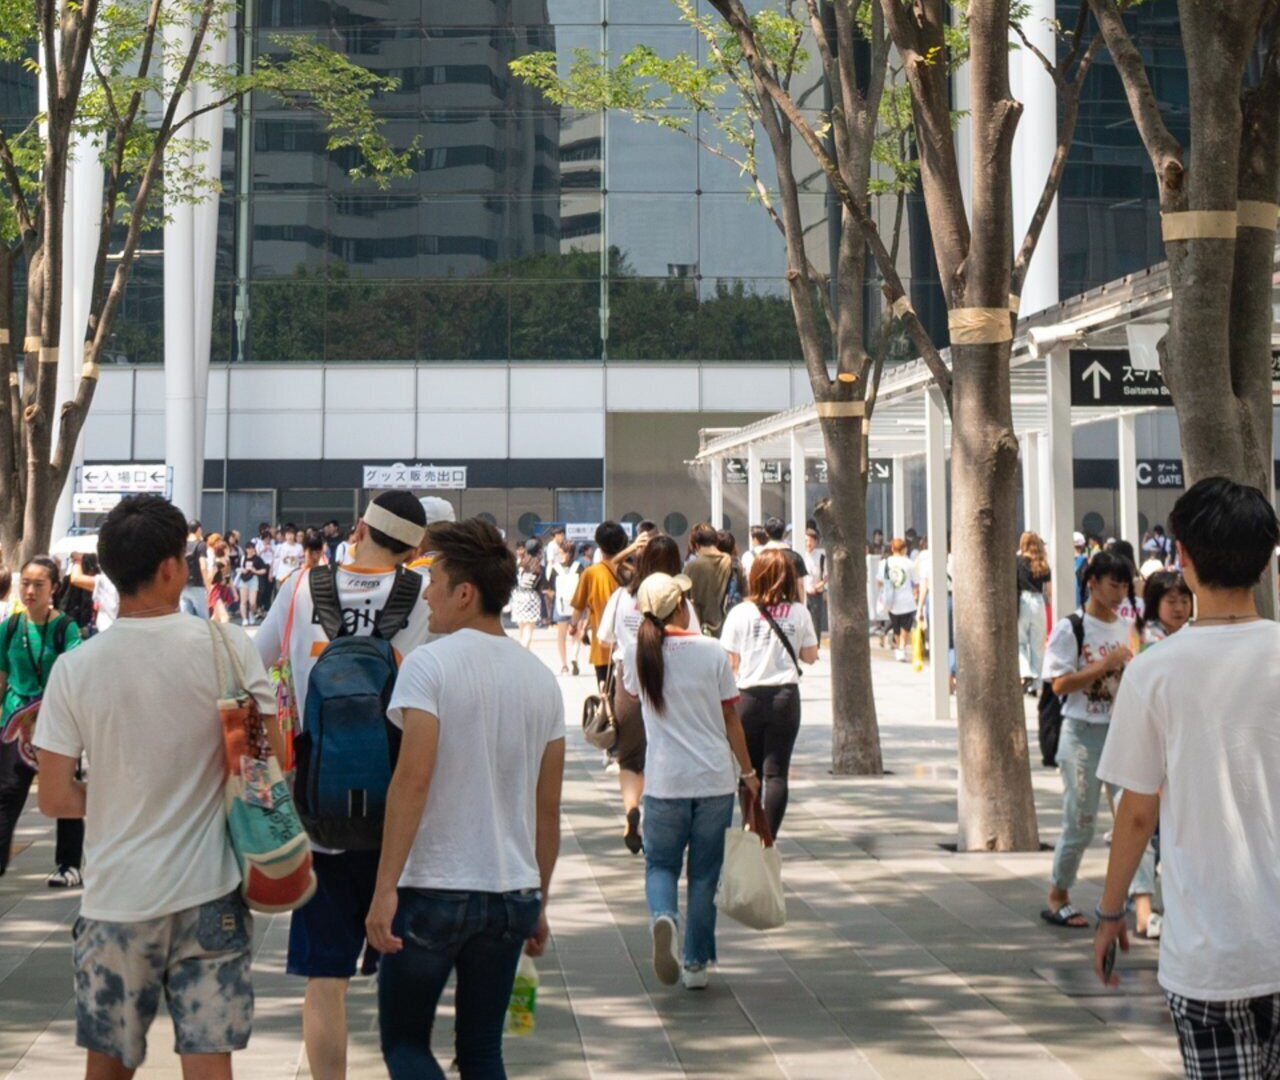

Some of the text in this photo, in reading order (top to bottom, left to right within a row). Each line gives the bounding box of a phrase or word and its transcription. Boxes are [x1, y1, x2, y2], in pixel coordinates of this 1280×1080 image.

[1123, 386, 1159, 395] Saitama
[1157, 463, 1178, 472] ゲート
[102, 471, 147, 482] 入場口
[367, 470, 464, 482] グッズ販売出口
[1136, 462, 1152, 485] C
[1157, 474, 1182, 485] GATE
